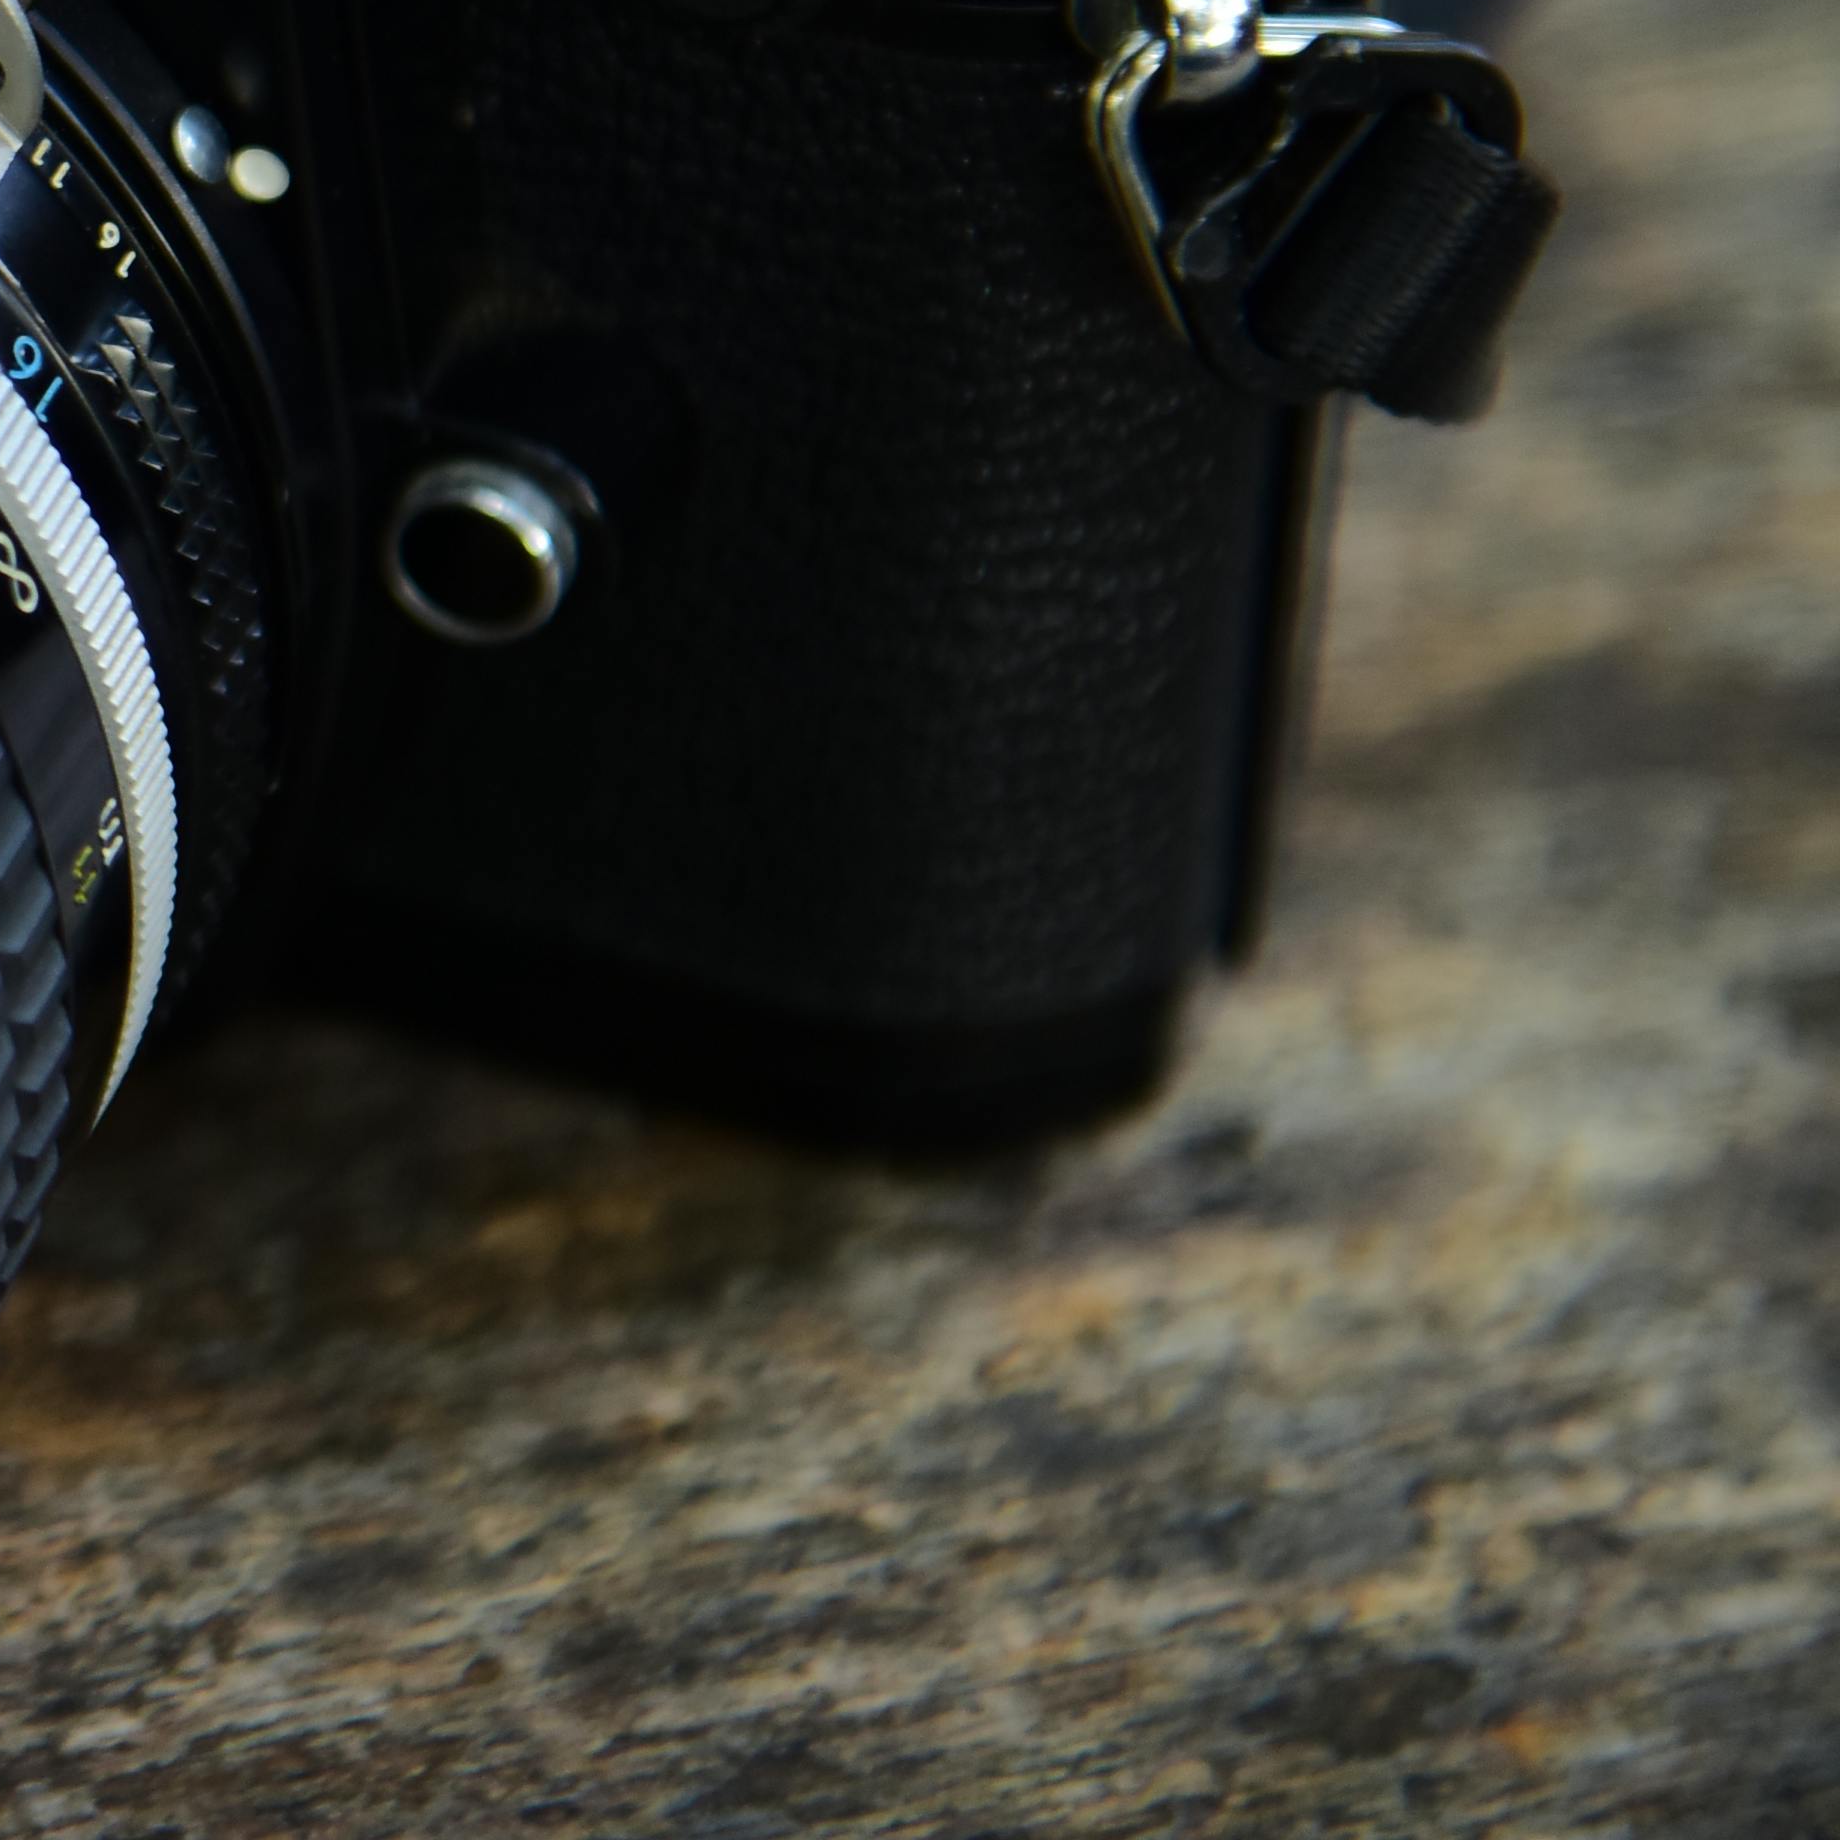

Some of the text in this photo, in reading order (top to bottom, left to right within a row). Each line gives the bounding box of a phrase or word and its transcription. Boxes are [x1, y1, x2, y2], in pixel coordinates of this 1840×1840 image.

[30, 135, 73, 189] 11
[96, 220, 137, 279] 16
[8, 332, 65, 424] 16
